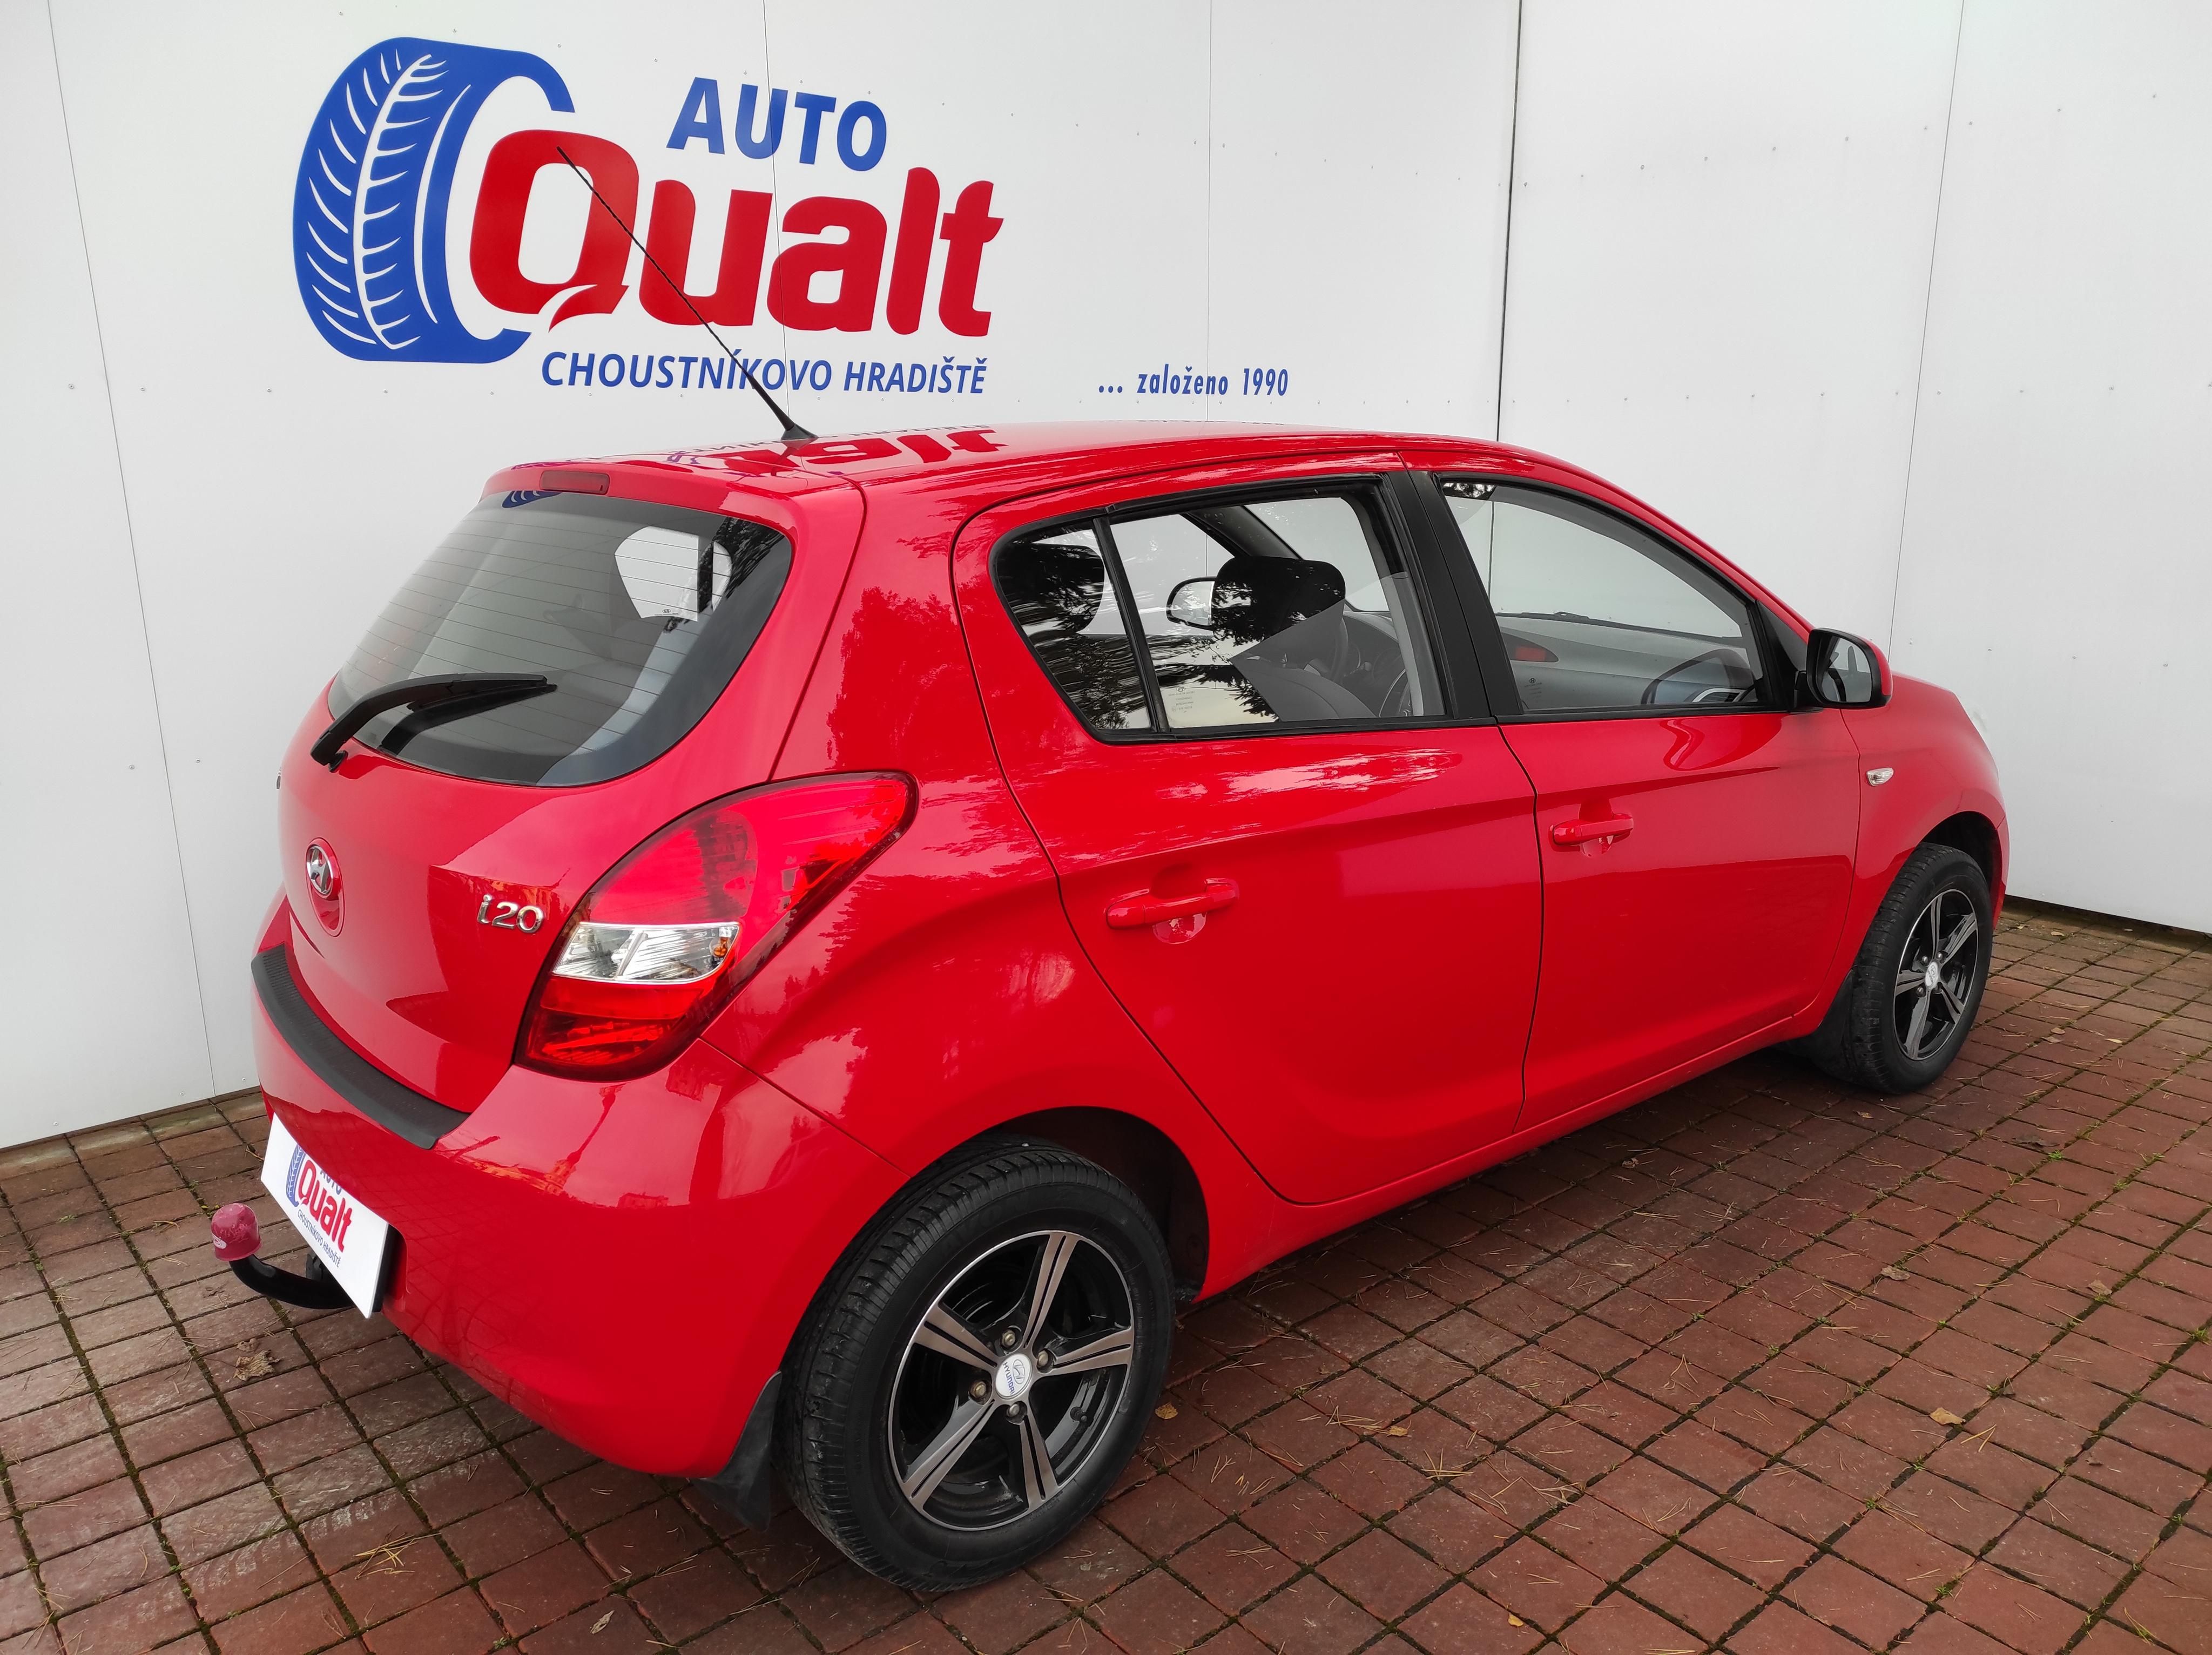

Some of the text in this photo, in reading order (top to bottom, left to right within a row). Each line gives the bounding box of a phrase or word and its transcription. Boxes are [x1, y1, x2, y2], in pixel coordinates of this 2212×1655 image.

[666, 77, 887, 172] AUTO
[469, 129, 1004, 336] Qualt
[542, 349, 988, 394] CHOUSTNÍKOVO HRADIŠTĚ
[1137, 363, 1229, 395] založeno
[1243, 368, 1289, 396] 1990
[477, 894, 544, 933] i20
[298, 1159, 353, 1253] Qualt
[298, 1209, 341, 1268] CHOUSTNÍKOVO HRADIŠTĚ
[1002, 1361, 1015, 1395] HYUNDAI
